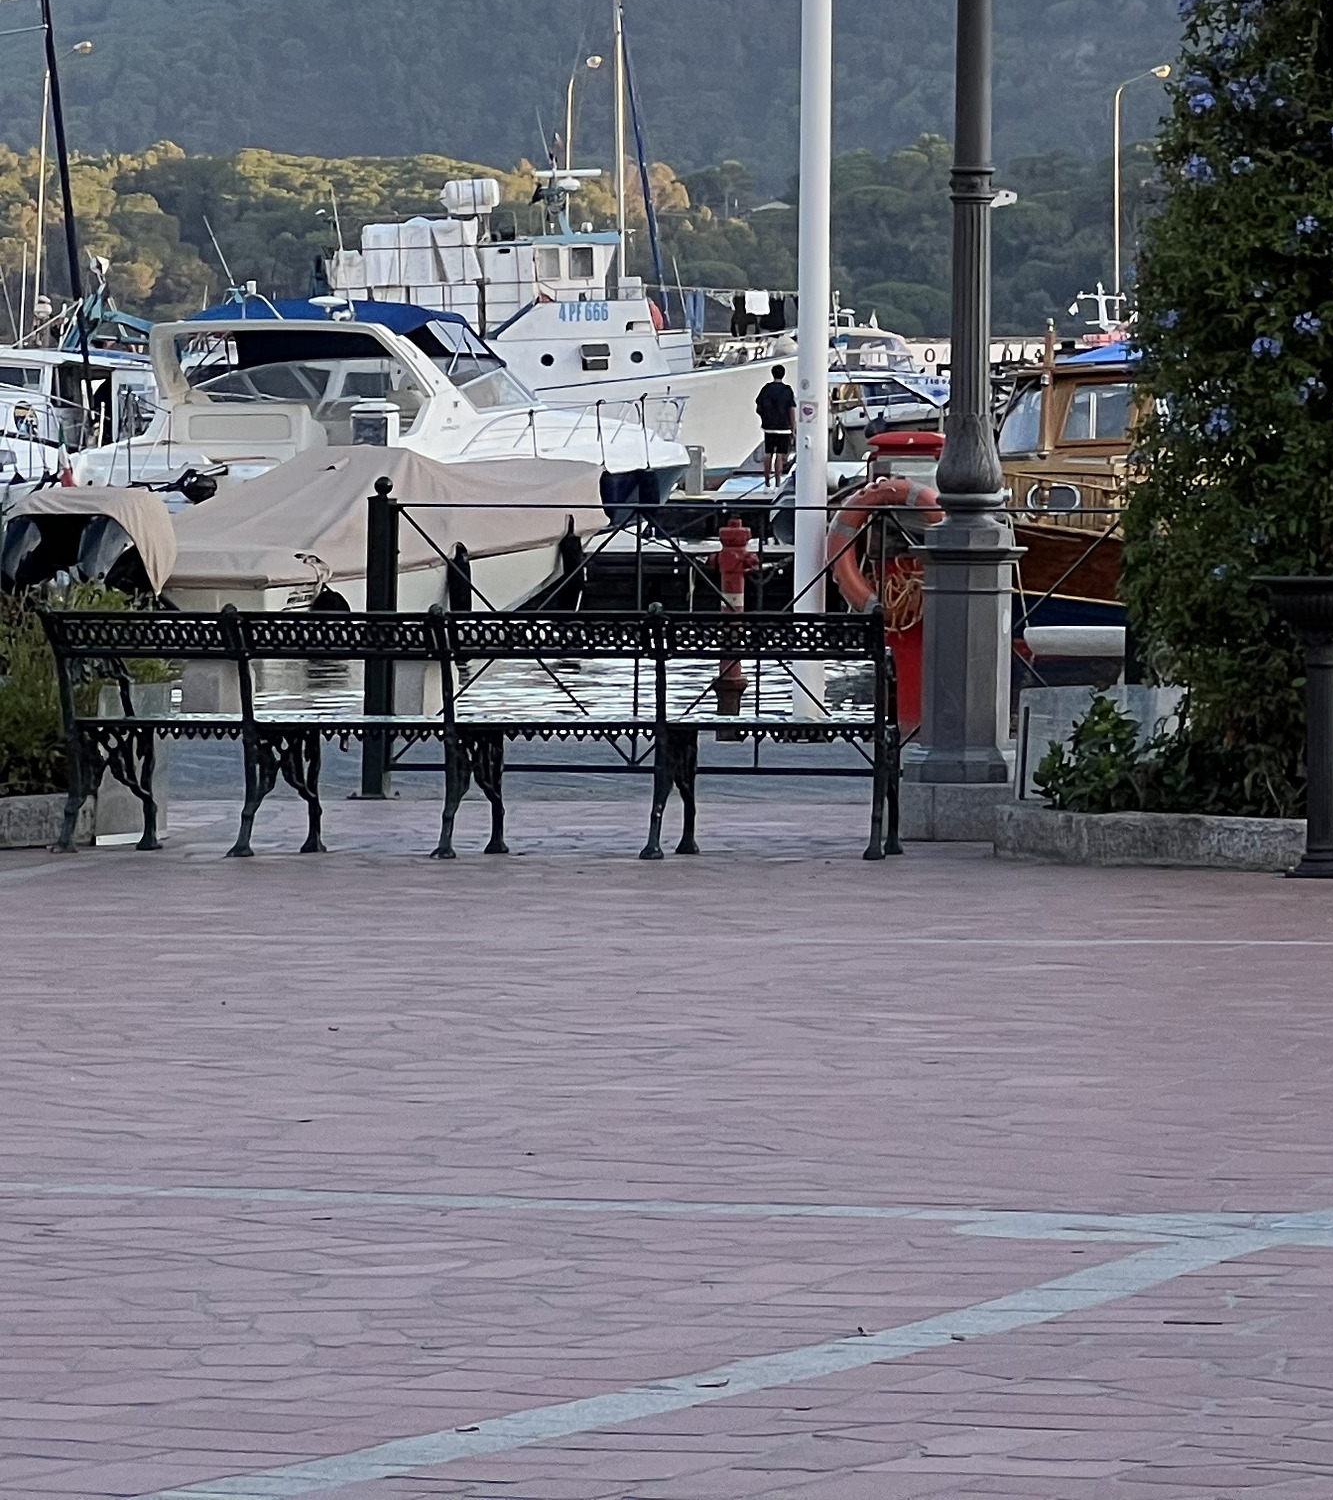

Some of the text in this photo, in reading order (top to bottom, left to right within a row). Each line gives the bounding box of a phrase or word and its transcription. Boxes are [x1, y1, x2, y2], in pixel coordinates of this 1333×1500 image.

[559, 301, 609, 322] 4 PF 666
